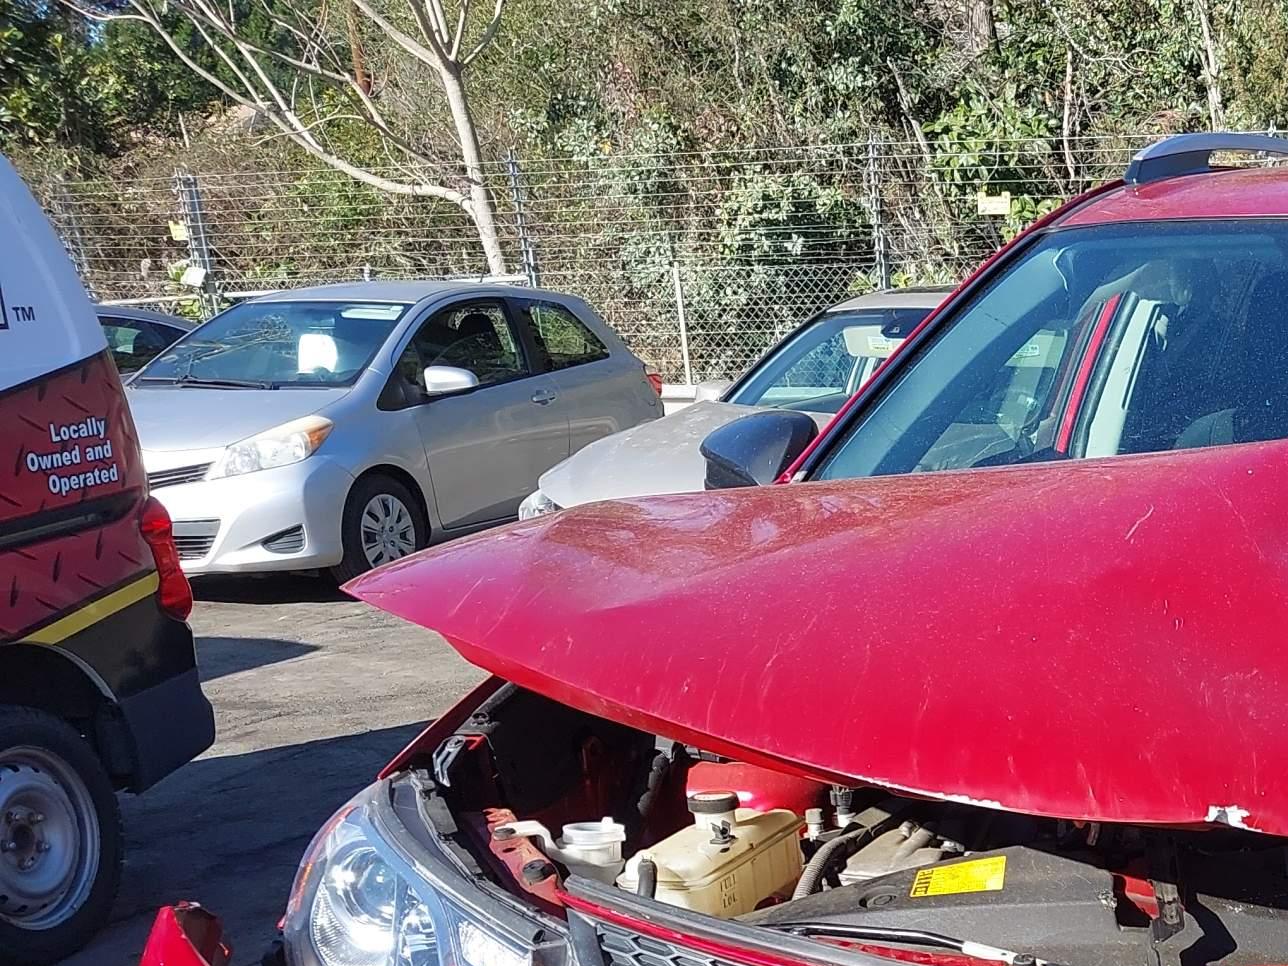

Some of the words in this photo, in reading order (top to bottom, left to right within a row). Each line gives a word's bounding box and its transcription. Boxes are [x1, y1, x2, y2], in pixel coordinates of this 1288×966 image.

[11, 306, 36, 322] TM
[49, 416, 105, 442] Locally
[26, 445, 81, 472] Owned
[85, 439, 113, 461] and
[48, 463, 119, 496] Operated
